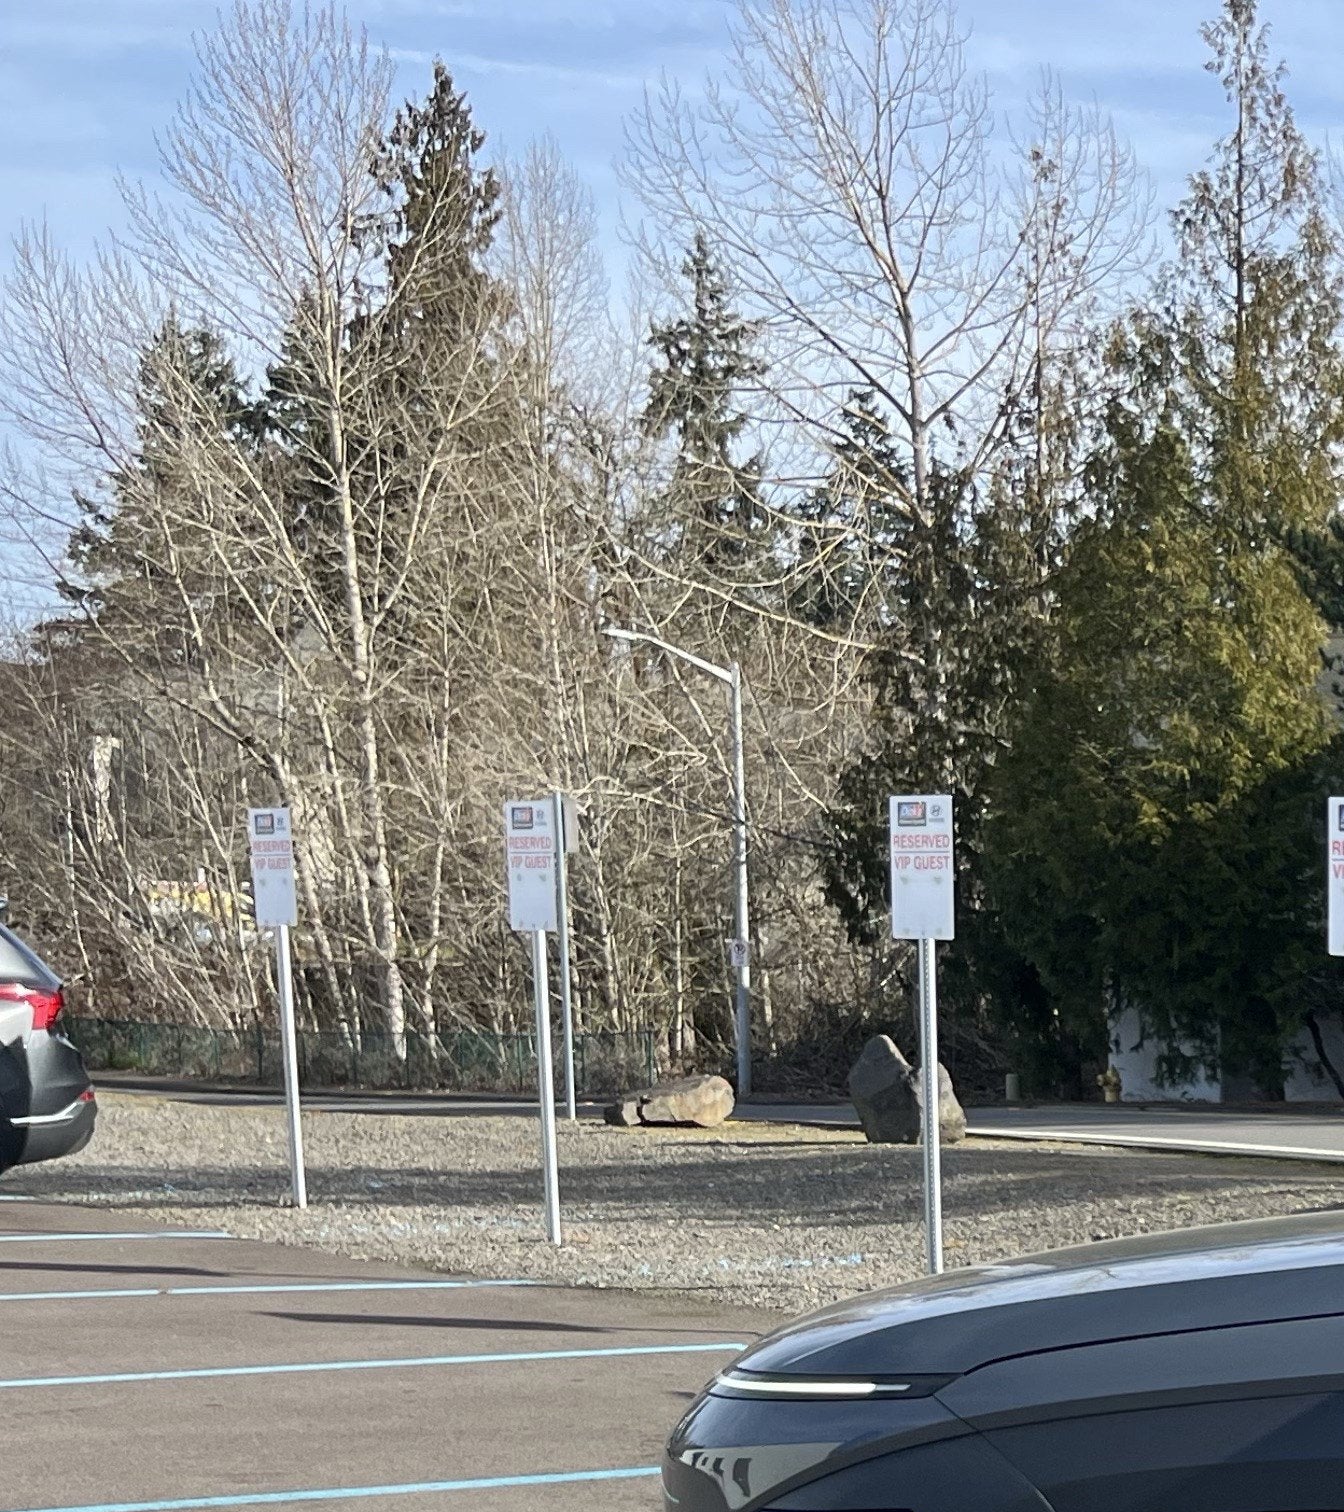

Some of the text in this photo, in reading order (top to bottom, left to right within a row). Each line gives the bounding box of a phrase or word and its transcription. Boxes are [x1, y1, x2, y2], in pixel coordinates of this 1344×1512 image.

[509, 836, 552, 850] RESERVED
[893, 834, 950, 848] RESERVED
[525, 855, 552, 868] GUEST
[894, 855, 951, 870] VIP GUEST
